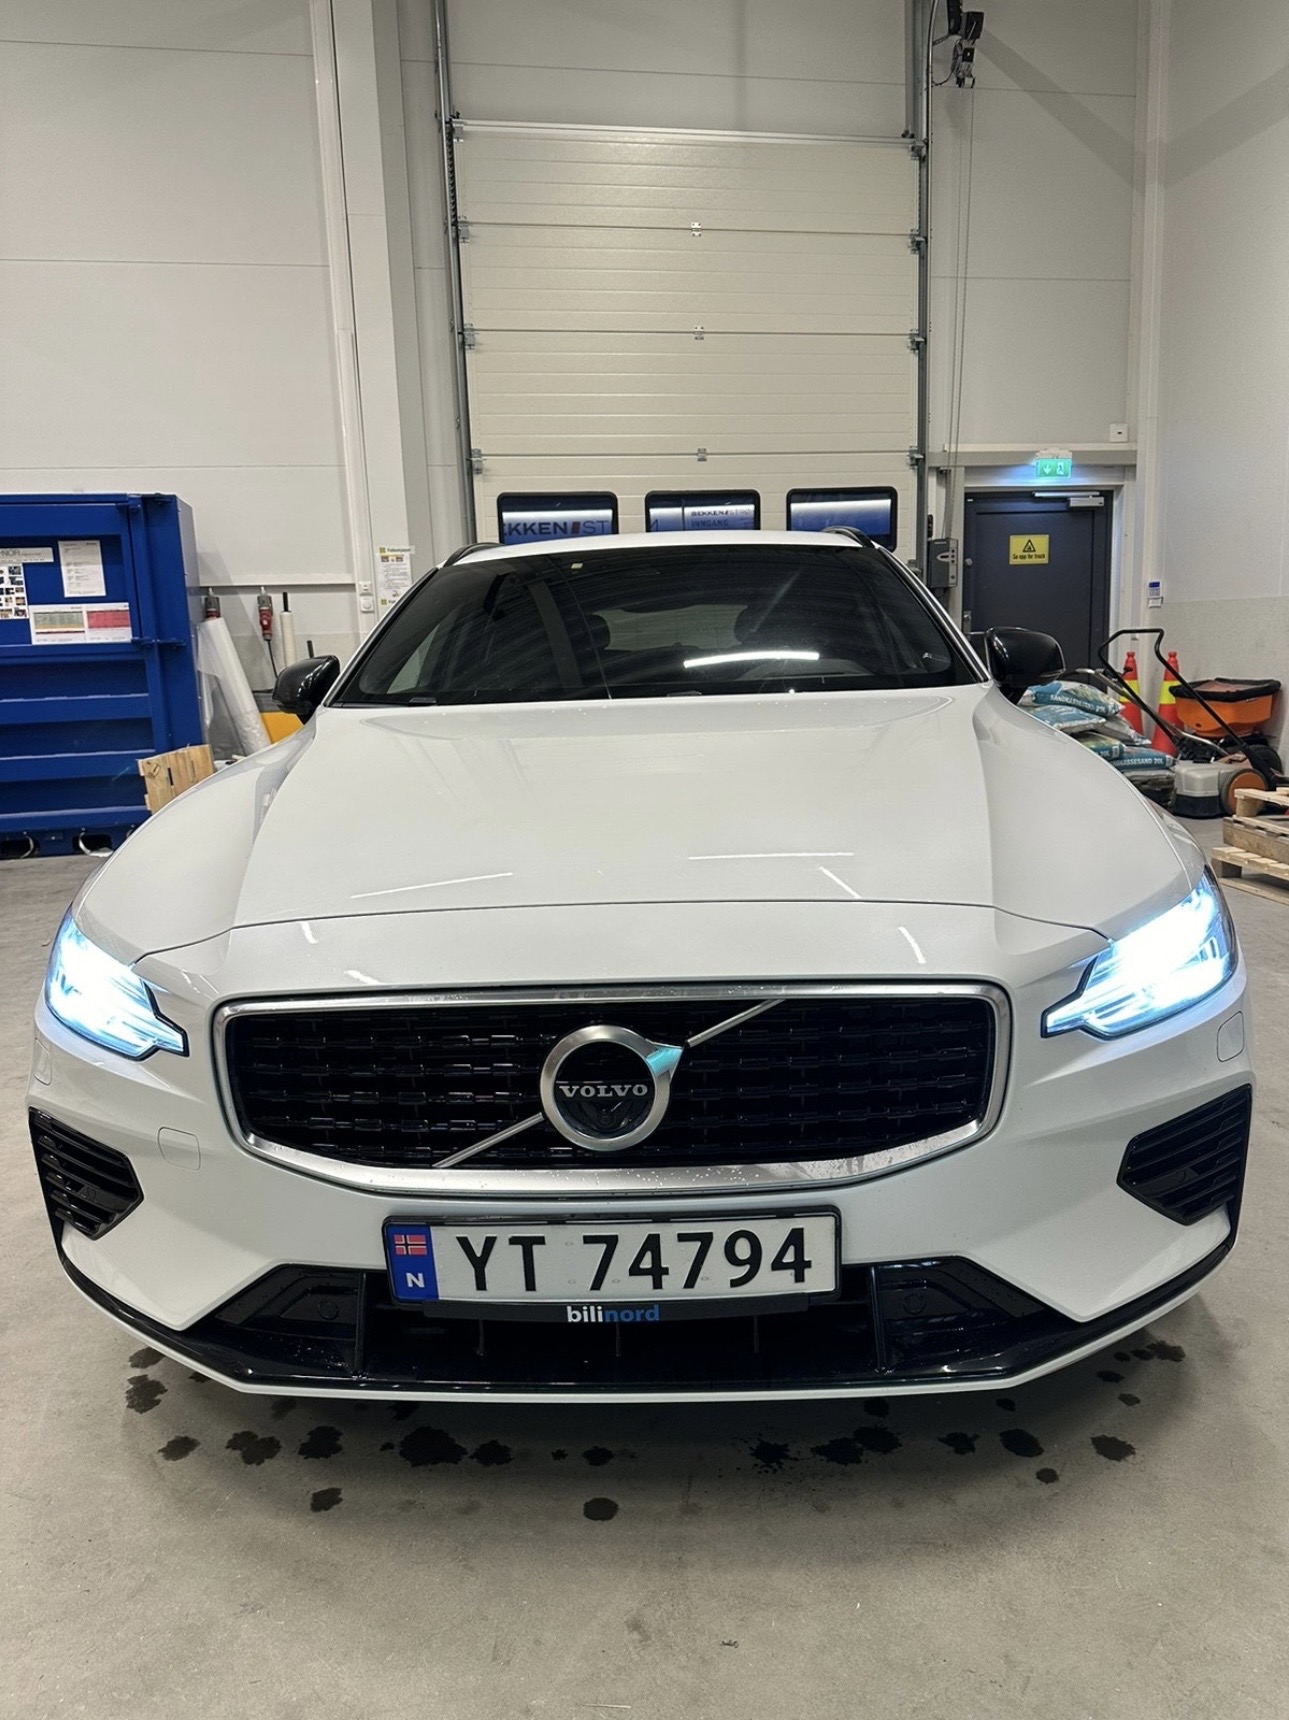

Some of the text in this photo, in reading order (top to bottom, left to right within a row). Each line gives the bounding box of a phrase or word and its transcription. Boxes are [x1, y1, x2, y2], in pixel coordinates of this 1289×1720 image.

[558, 1084, 648, 1098] VOLVO
[455, 1227, 812, 1292] YT 74794
[405, 1272, 425, 1289] N
[566, 1304, 660, 1323] bilinord
